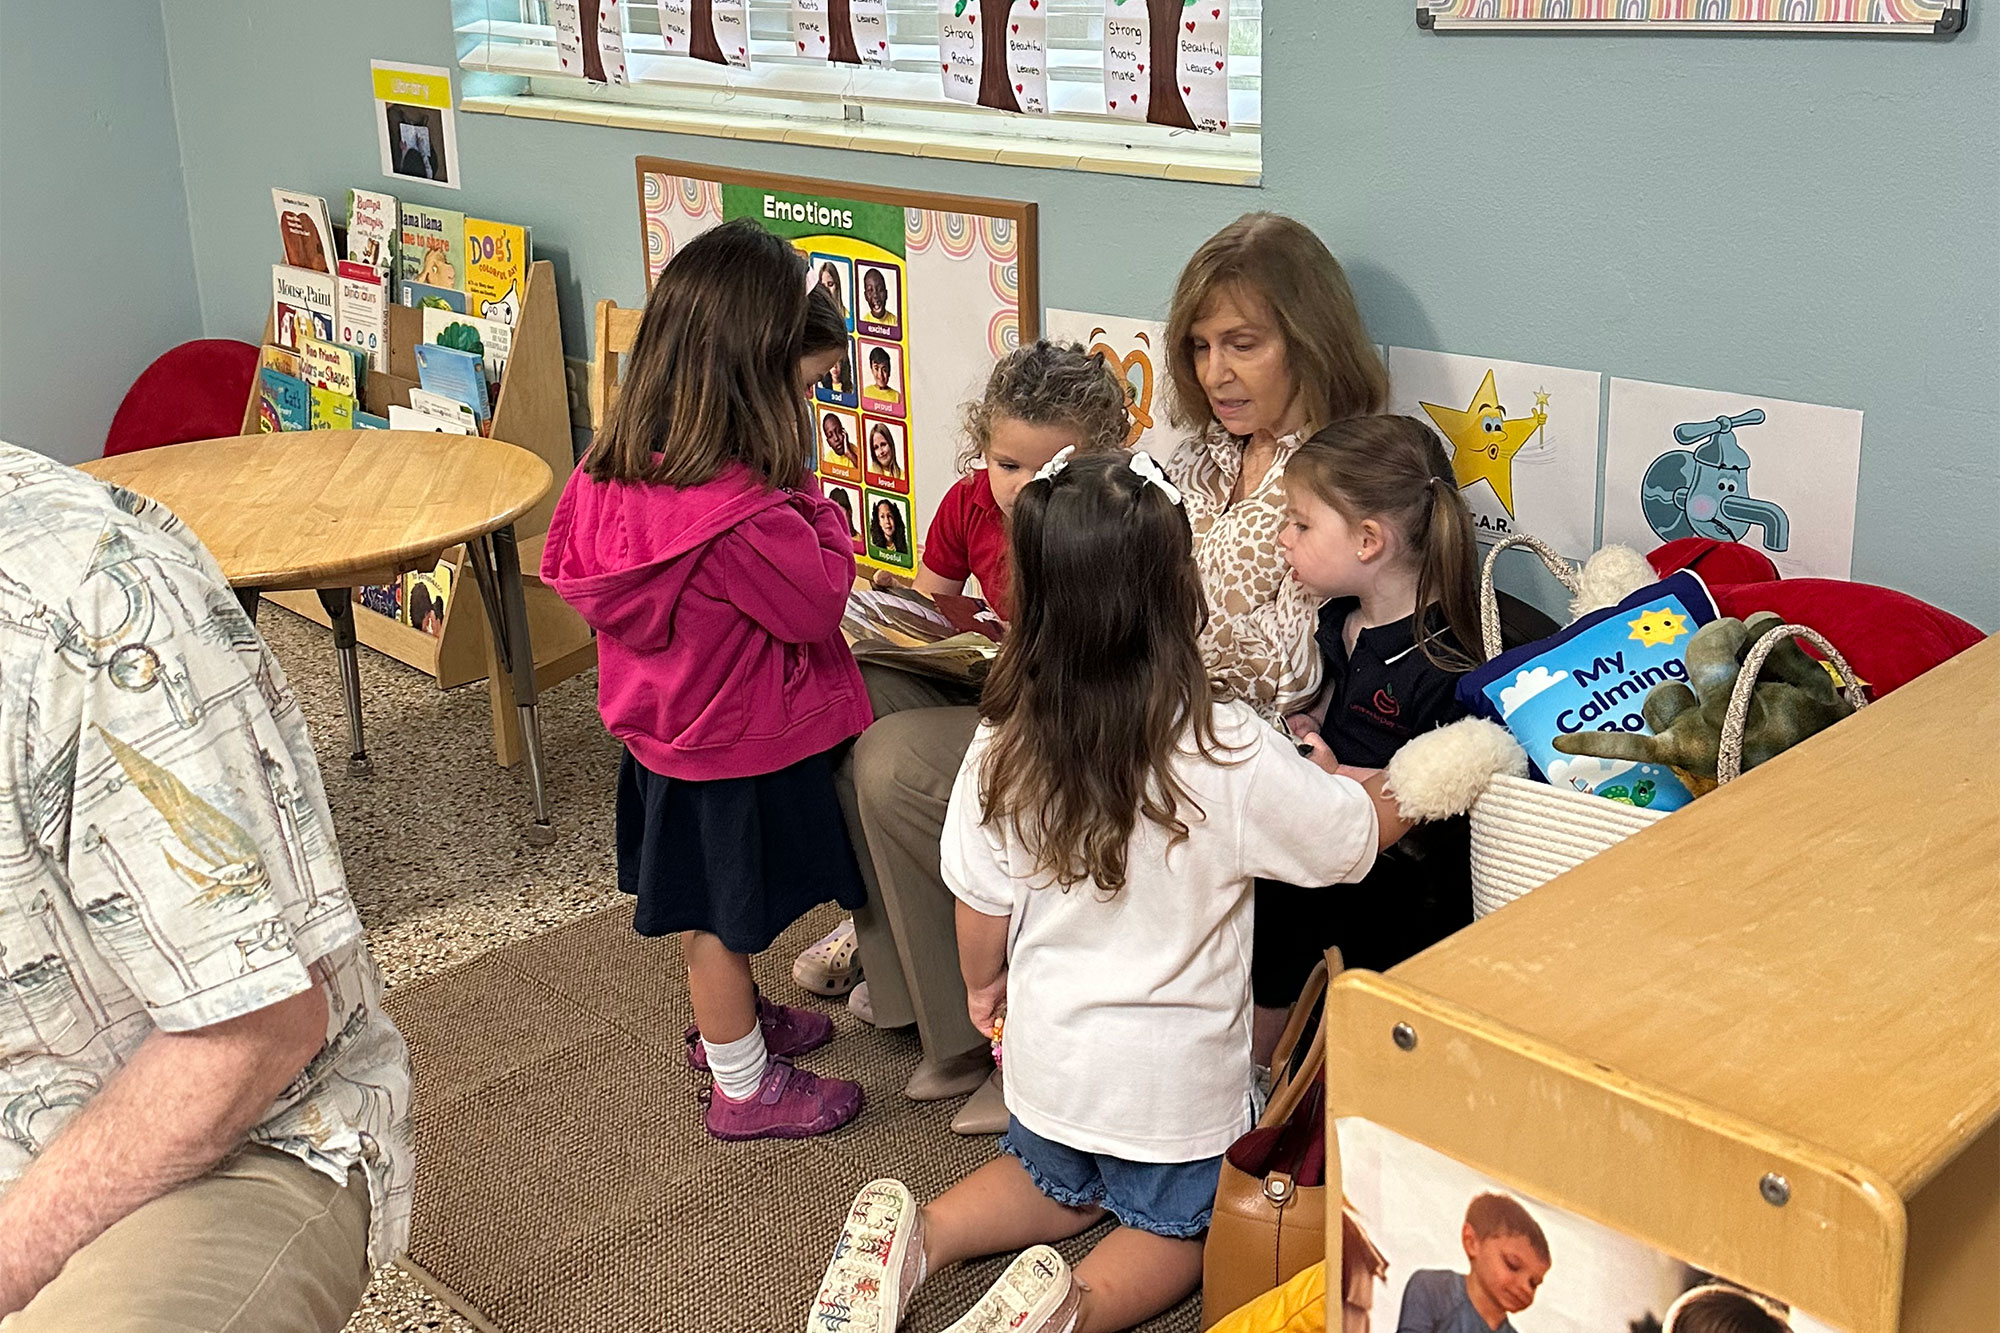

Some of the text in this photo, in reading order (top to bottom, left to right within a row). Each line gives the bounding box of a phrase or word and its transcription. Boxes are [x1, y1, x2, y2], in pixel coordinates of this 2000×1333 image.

[665, 2, 685, 15] Roots
[856, 13, 880, 25] Leaves
[944, 24, 975, 49] Strong
[1109, 22, 1142, 45] Strong
[1010, 40, 1043, 53] Beautiful
[1110, 47, 1136, 61] Roots
[1181, 40, 1223, 57] Beautiful
[951, 51, 975, 66] Roots
[1016, 63, 1040, 75] Leaves
[1186, 63, 1214, 75] Leaves
[763, 194, 854, 229] Emotions
[421, 213, 443, 232] llama
[417, 232, 425, 247] to
[427, 233, 450, 252] share
[470, 229, 511, 265] Dog's
[278, 278, 304, 299] Mouse
[306, 285, 332, 307] Paint
[868, 324, 892, 336] excited
[319, 348, 340, 365] Friends
[325, 366, 350, 390] Shapes
[831, 393, 842, 402] sad
[874, 402, 893, 413] proud
[831, 466, 850, 477] bored
[878, 477, 895, 489] loved
[879, 551, 902, 563] hopeful
[1572, 651, 1624, 688] My
[1556, 657, 1690, 734] Calming
